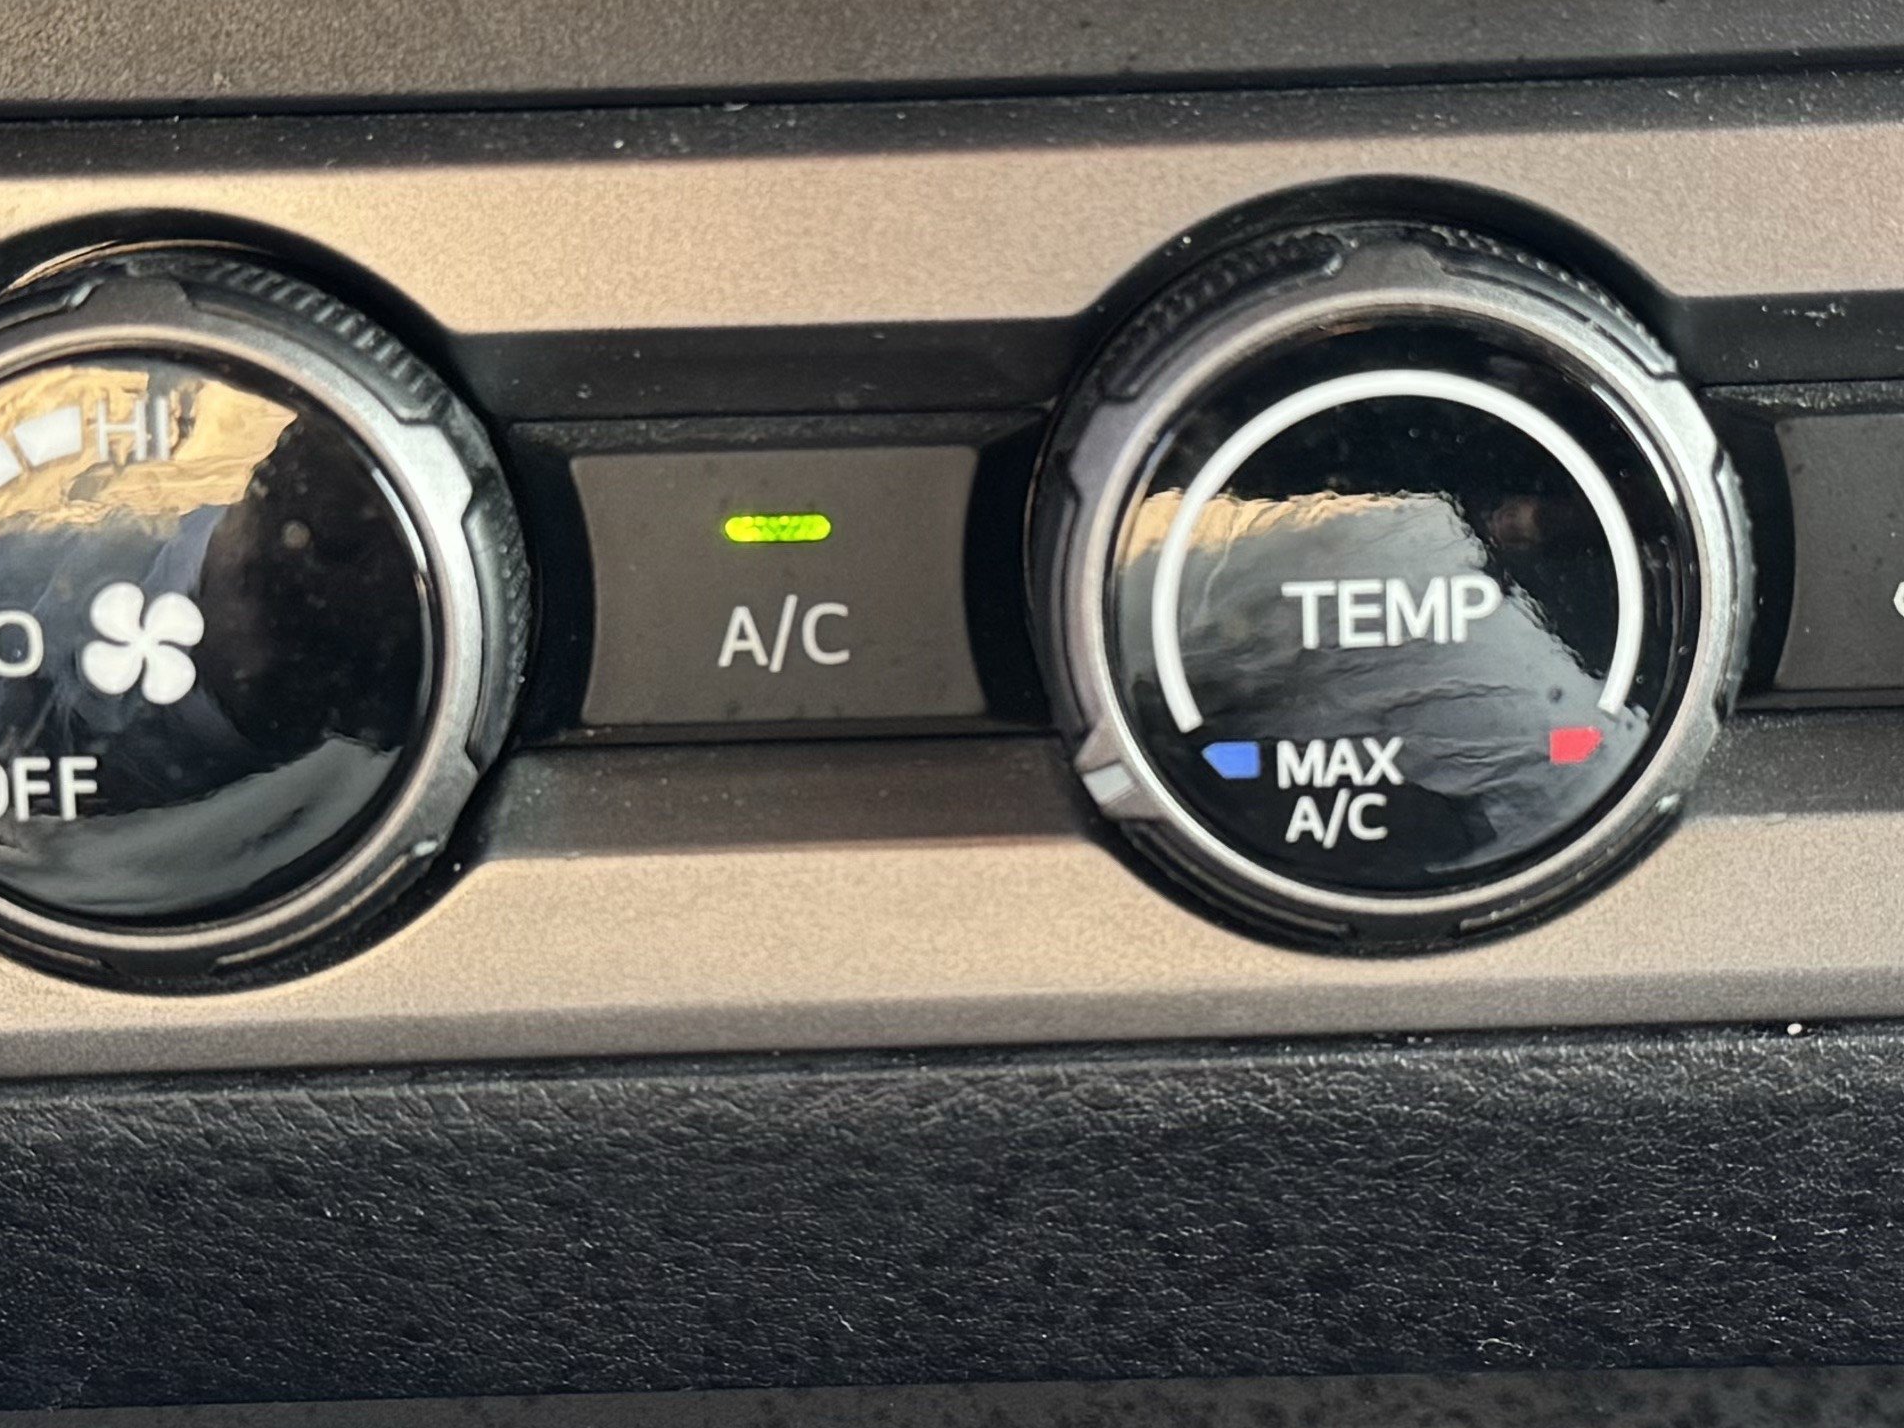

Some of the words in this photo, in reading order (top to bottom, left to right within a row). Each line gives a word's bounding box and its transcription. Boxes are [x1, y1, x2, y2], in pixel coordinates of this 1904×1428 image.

[96, 393, 172, 463] HI
[716, 593, 851, 674] A/C
[1280, 573, 1503, 650] TEMP
[1275, 735, 1406, 790] MAX
[1284, 787, 1389, 850] A/C
